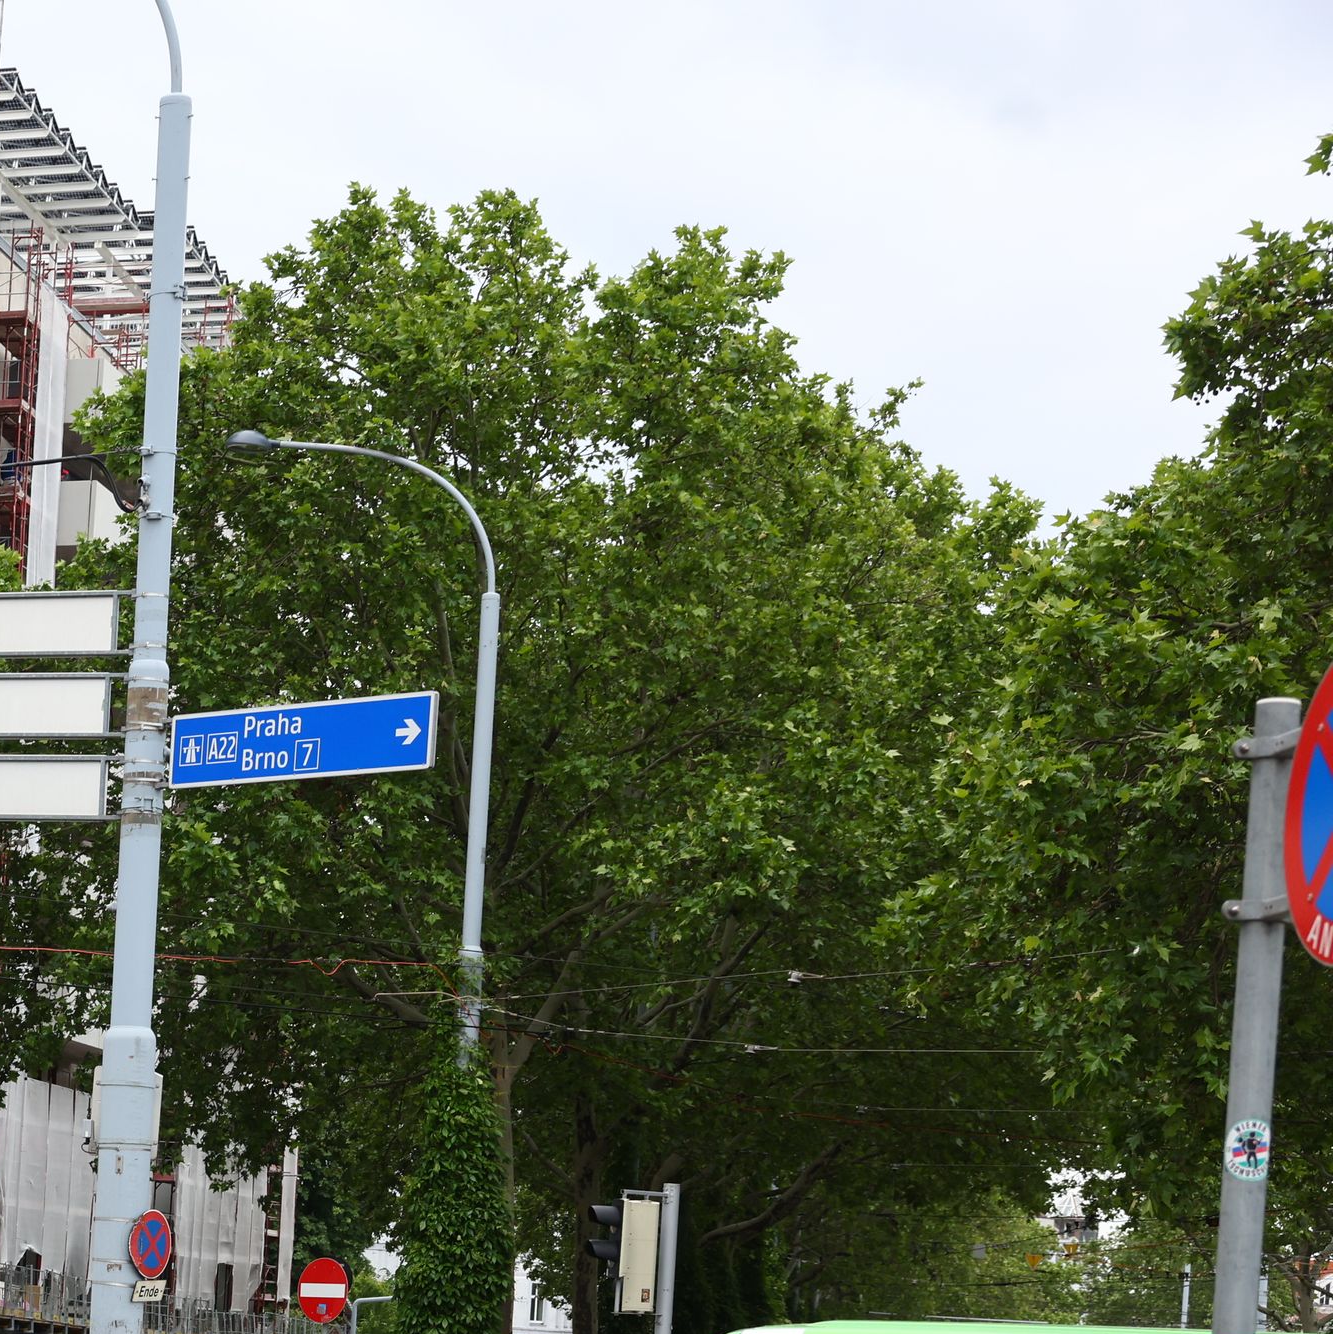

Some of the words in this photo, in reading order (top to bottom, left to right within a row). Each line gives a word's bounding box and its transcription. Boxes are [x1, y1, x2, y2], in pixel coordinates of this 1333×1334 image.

[243, 713, 302, 738] Praha
[208, 736, 236, 760] A22
[241, 749, 288, 771] Brno
[302, 743, 314, 766] 7
[138, 1285, 159, 1297] Ende
